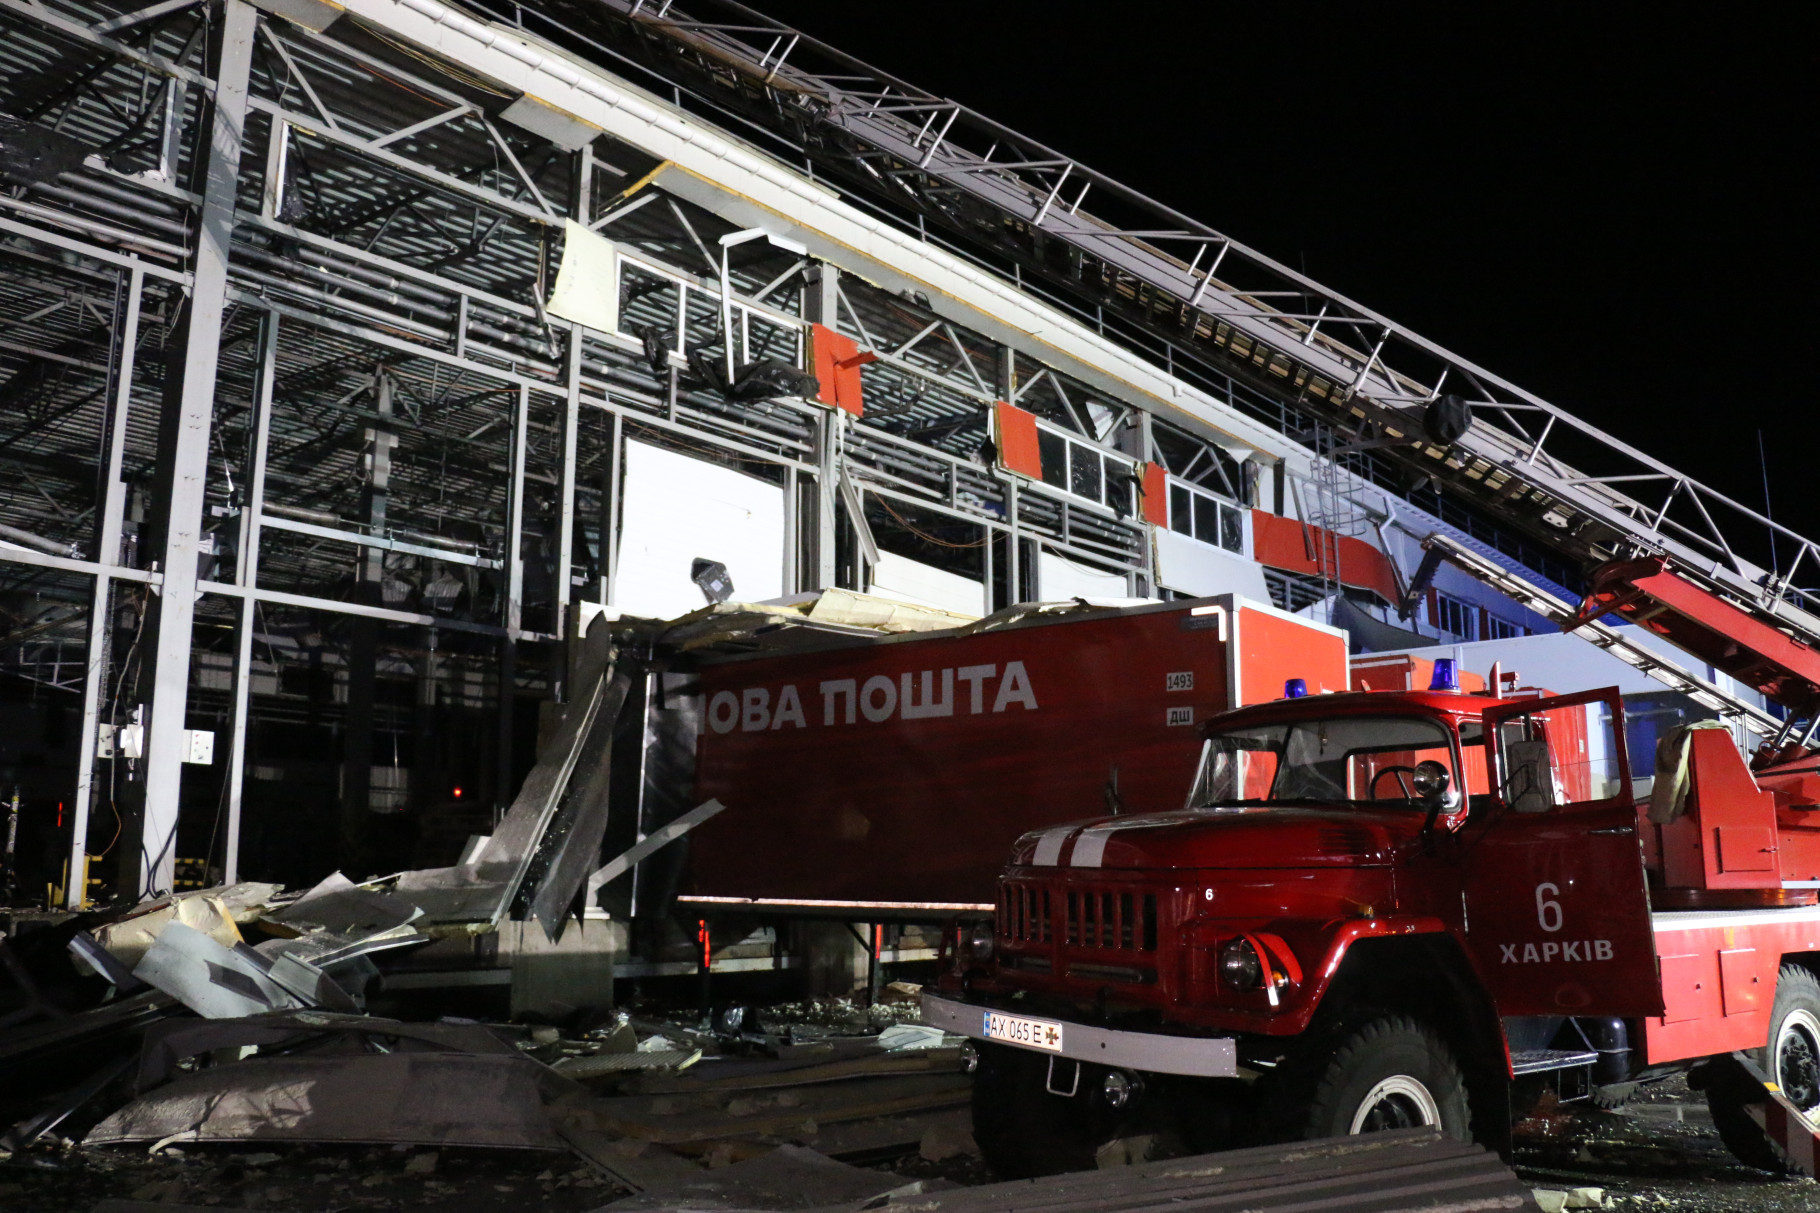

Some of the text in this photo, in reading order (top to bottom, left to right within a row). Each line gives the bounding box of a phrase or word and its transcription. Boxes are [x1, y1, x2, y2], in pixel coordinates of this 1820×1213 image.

[1167, 674, 1193, 689] 1493
[820, 660, 1039, 726] ПОШТА
[1169, 710, 1190, 725] ДШ
[1205, 888, 1213, 900] 6
[1535, 882, 1563, 932] 6
[1499, 939, 1614, 964] ХАРКІВ
[1009, 1020, 1030, 1041] 065
